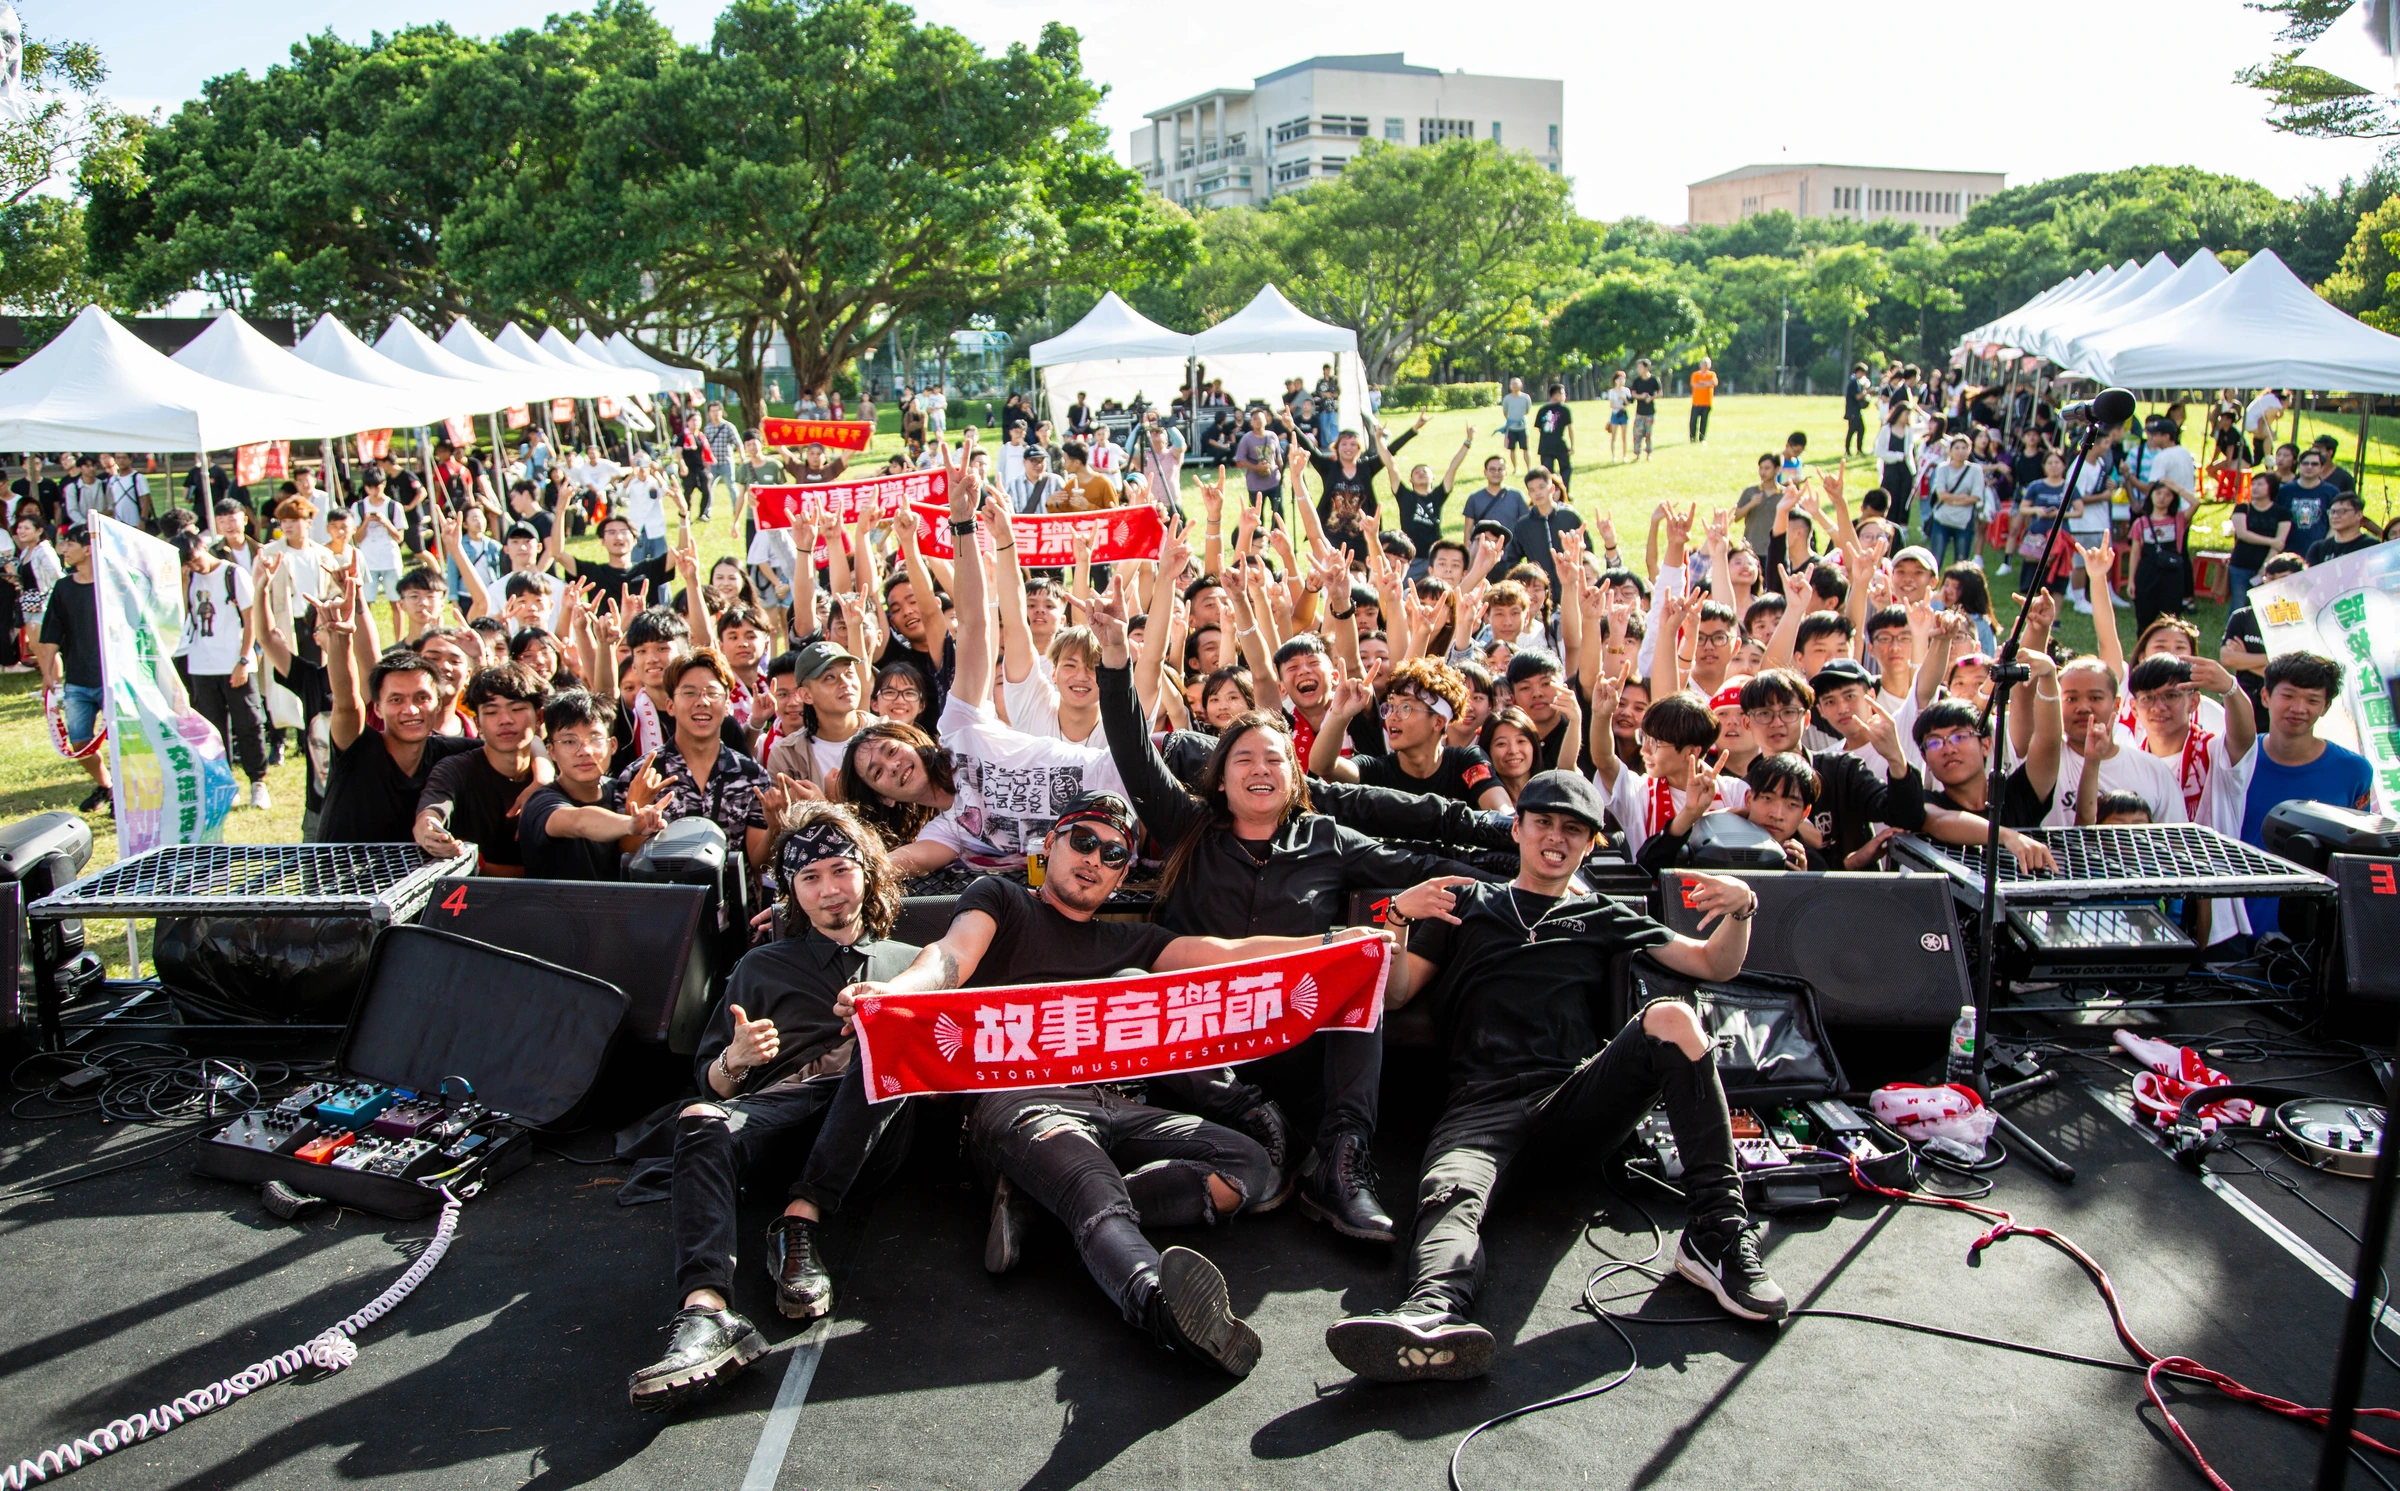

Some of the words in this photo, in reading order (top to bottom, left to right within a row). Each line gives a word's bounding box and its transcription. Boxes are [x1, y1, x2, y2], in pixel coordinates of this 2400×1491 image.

[441, 885, 468, 917] 4
[974, 971, 1285, 1063] 故事音樂節
[976, 1066, 1053, 1081] STORY
[1072, 1056, 1150, 1076] MUSIC
[1170, 1032, 1292, 1063] FESTIVAL
